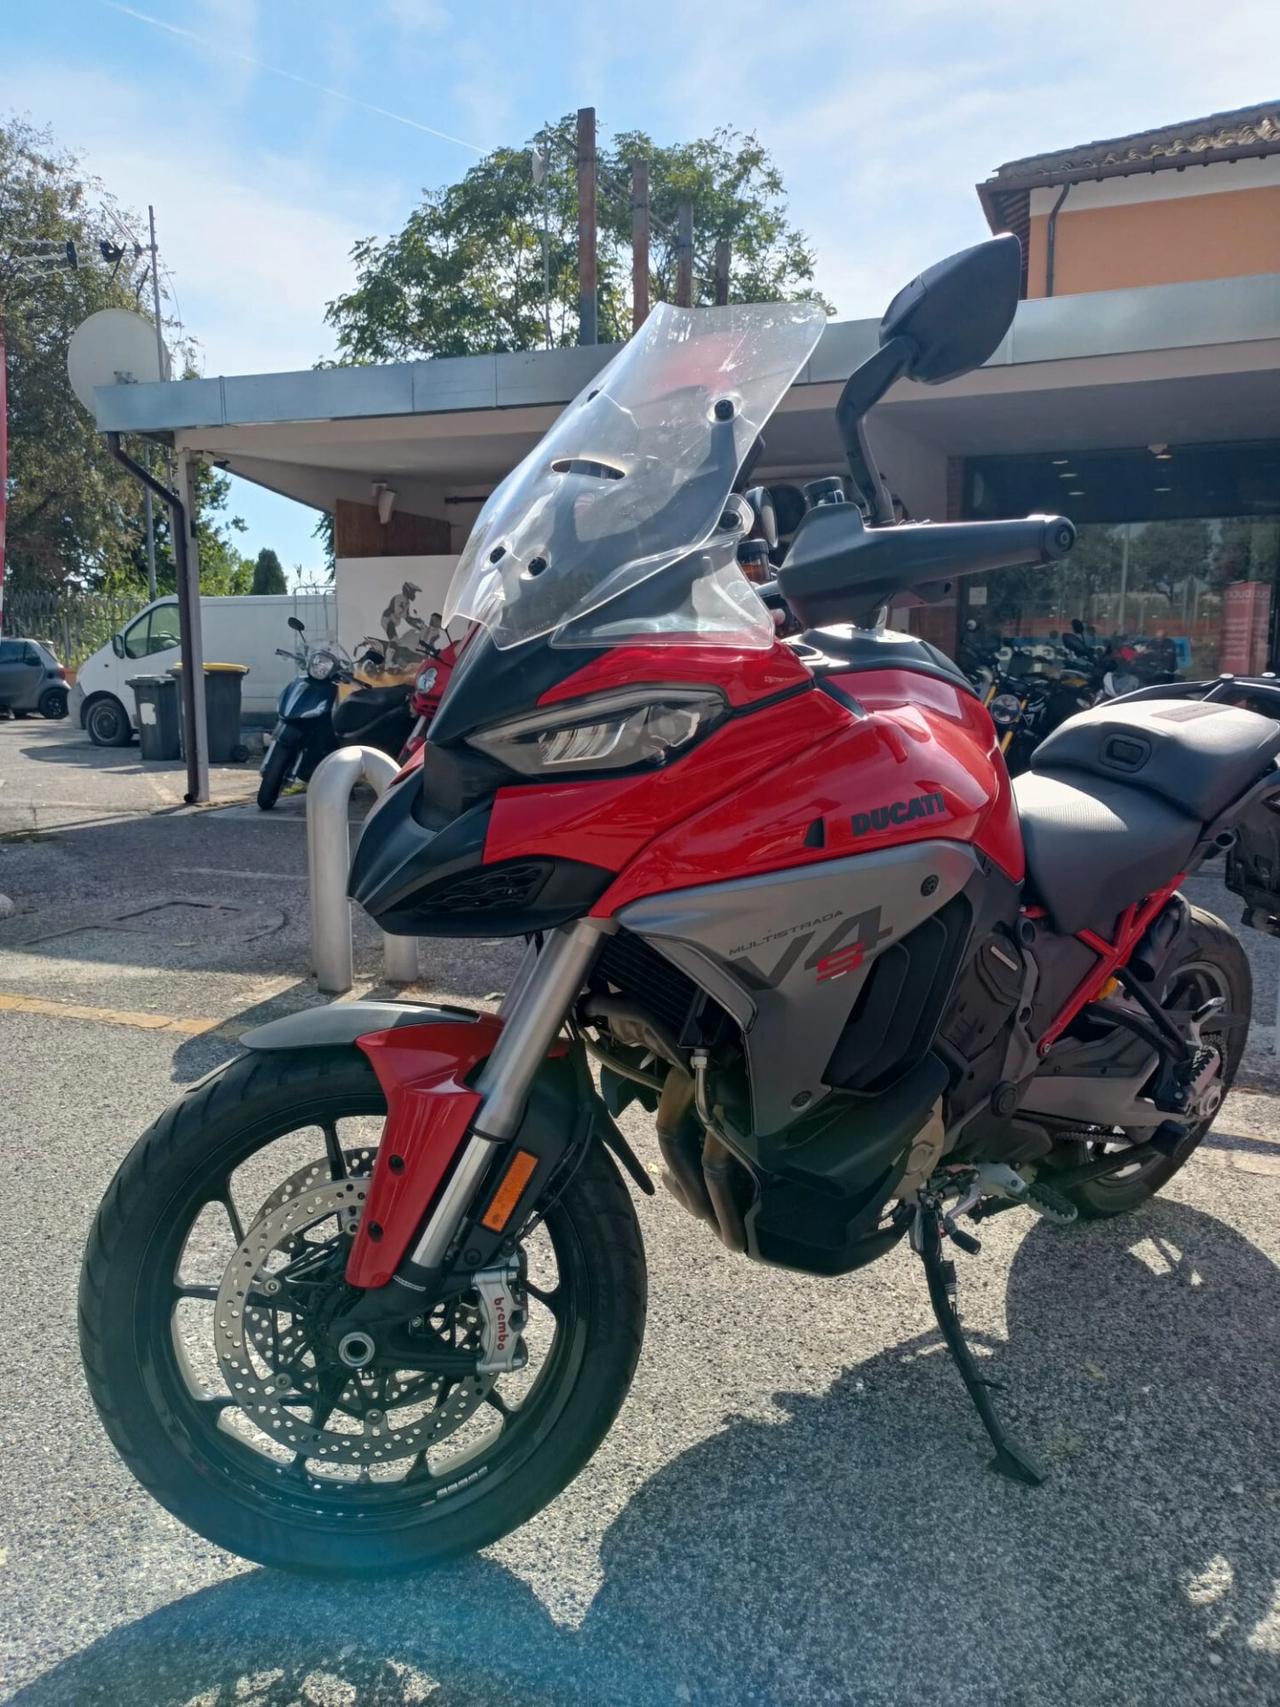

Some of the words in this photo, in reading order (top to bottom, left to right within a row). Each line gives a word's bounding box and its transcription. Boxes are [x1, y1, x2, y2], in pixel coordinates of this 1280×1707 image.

[851, 793, 945, 836] DUCATI
[723, 905, 893, 990] V4
[729, 910, 844, 955] MULTISTRADA
[494, 1297, 509, 1351] brembo
